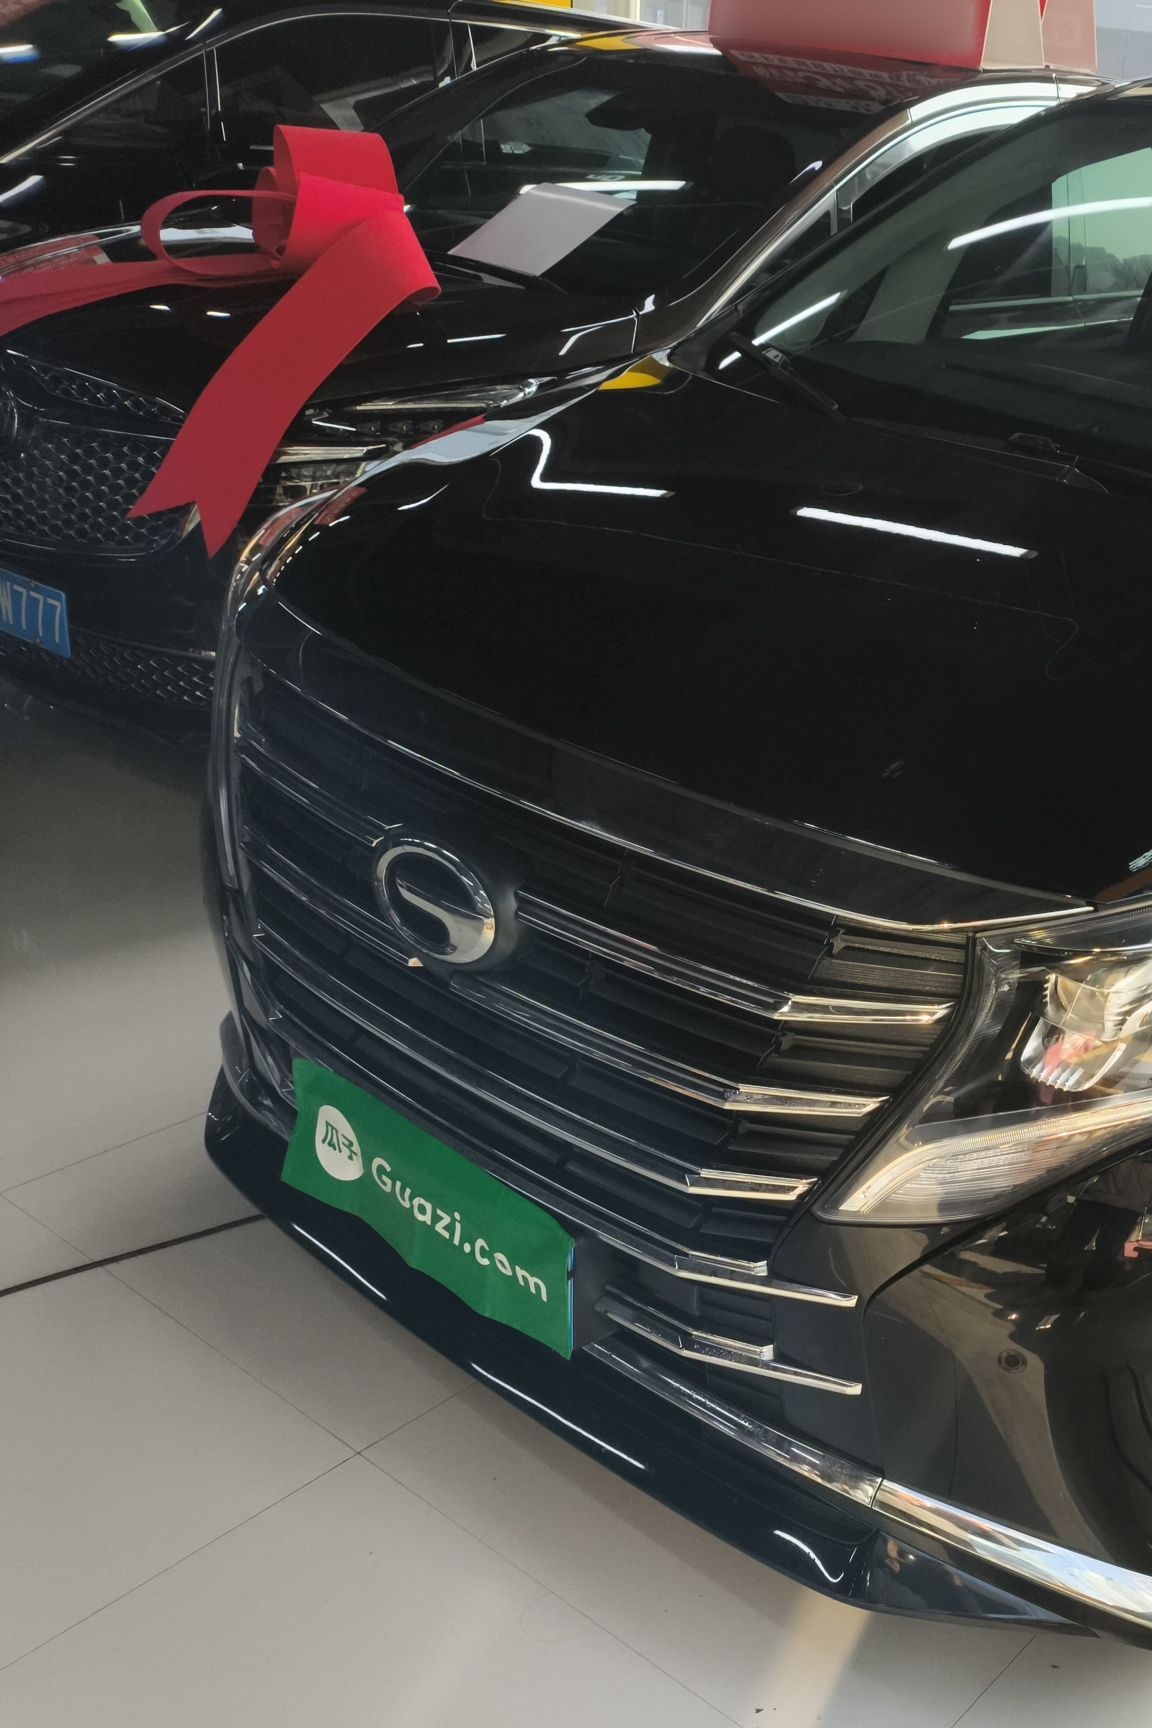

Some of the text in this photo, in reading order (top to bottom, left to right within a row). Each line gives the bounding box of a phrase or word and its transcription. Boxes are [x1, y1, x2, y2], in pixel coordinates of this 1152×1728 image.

[0, 581, 61, 643] W777
[321, 1119, 358, 1162] 瓜子
[371, 1157, 548, 1303] Guazi.com
